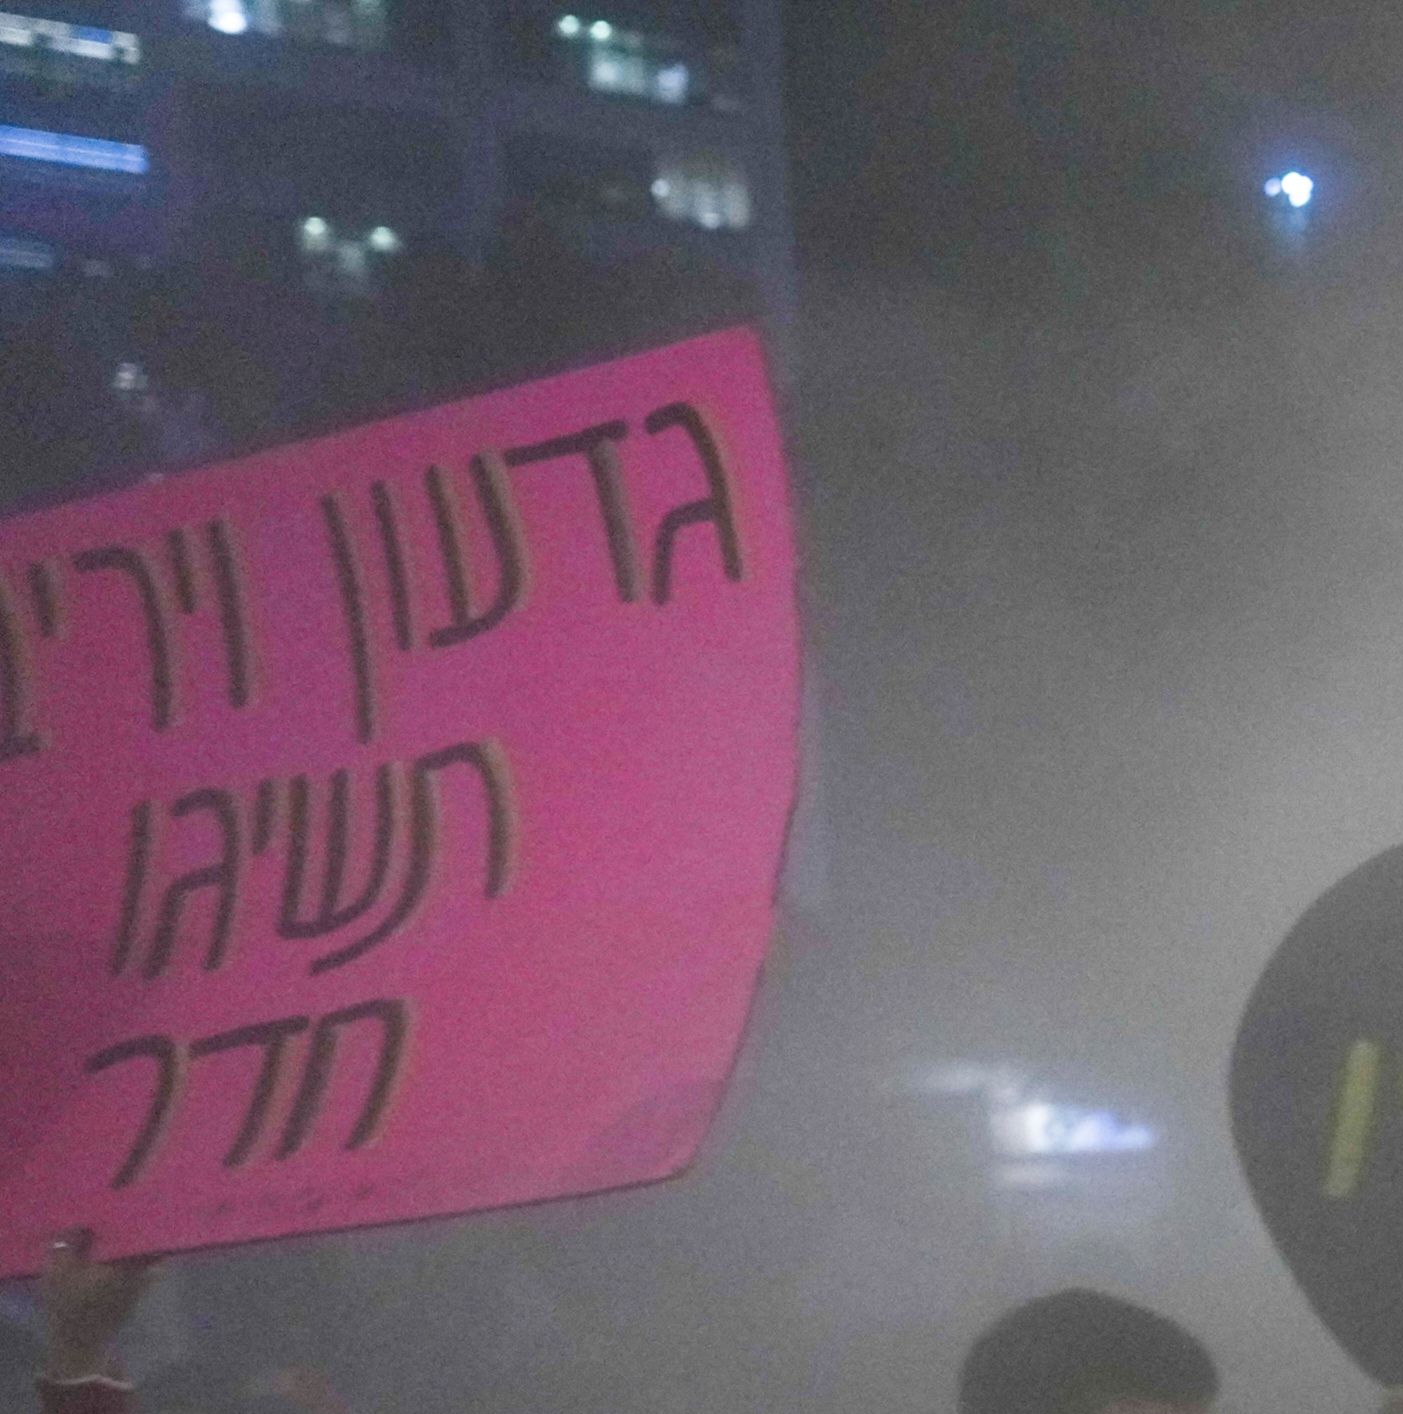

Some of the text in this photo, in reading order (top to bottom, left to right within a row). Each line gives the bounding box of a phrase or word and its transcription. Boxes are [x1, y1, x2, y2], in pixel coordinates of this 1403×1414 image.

[322, 400, 743, 743] גדעון
[111, 738, 509, 978] תשיגו
[84, 998, 406, 1189] חדר
